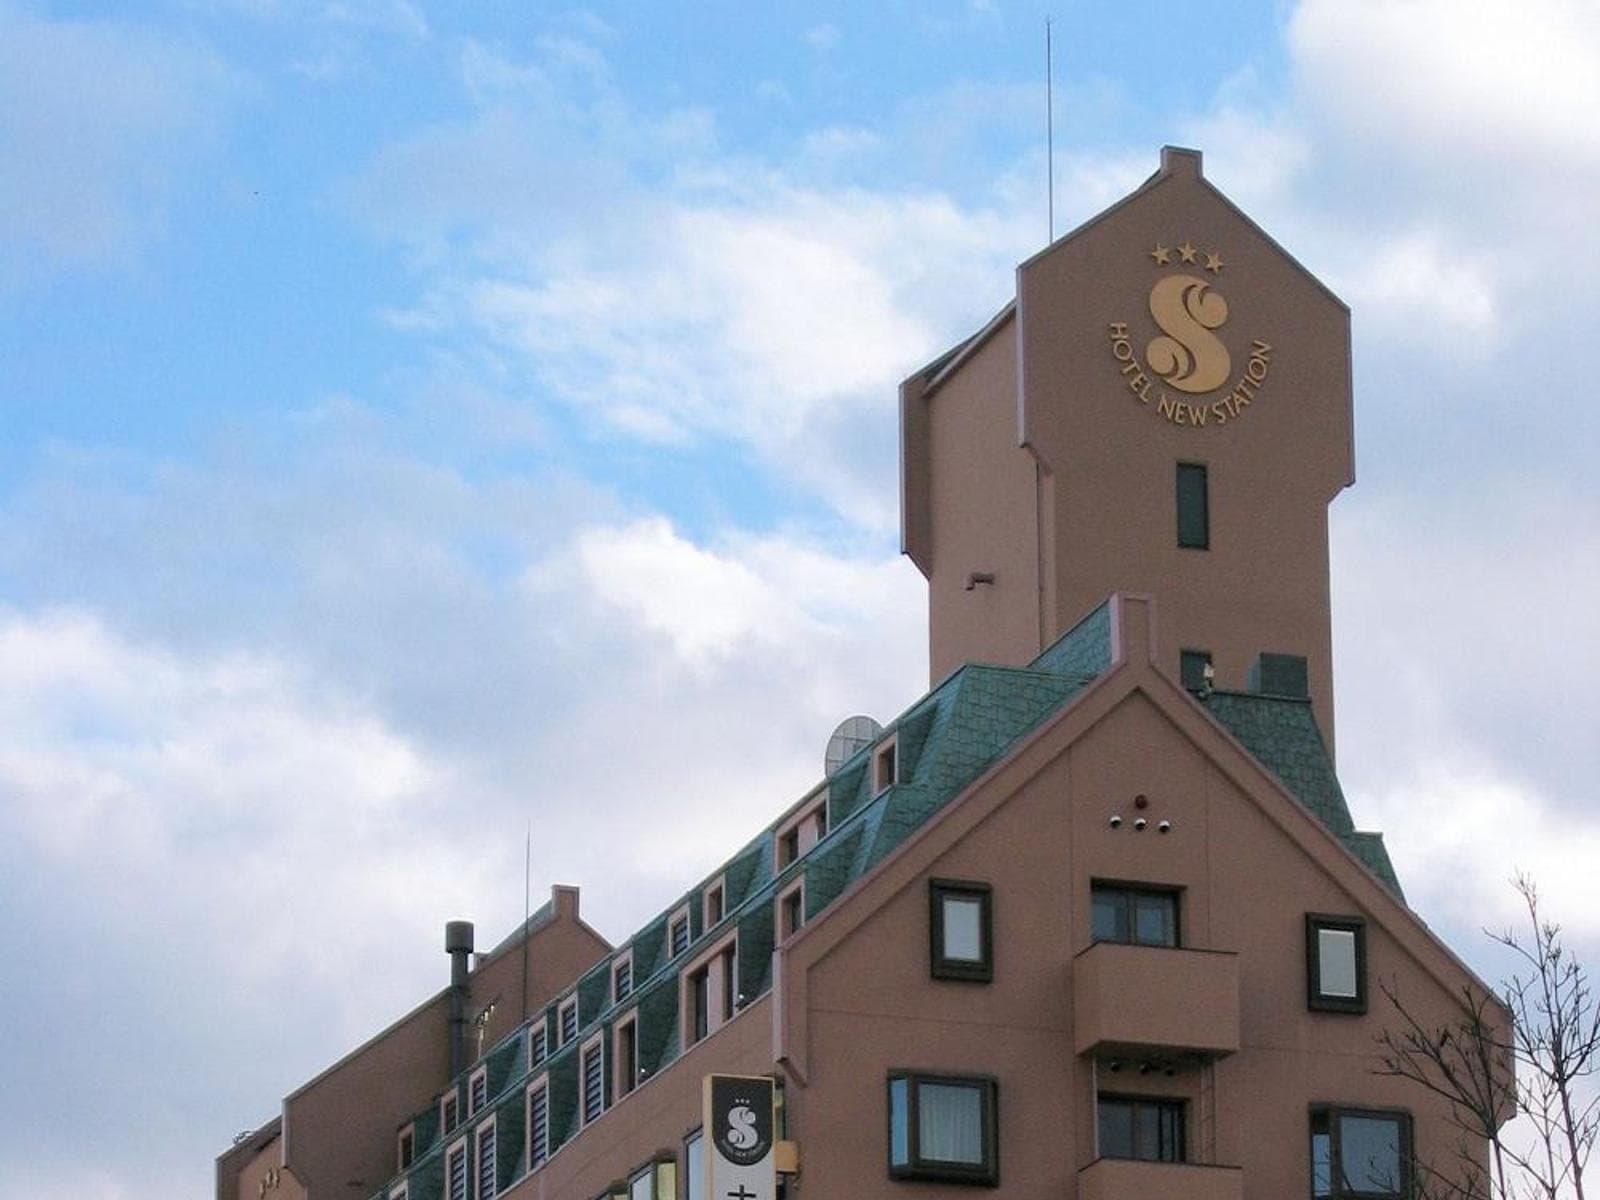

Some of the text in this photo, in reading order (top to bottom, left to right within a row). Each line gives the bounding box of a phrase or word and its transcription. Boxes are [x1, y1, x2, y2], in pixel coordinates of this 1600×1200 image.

[1110, 322, 1272, 426] HOTEL NEW STATION
